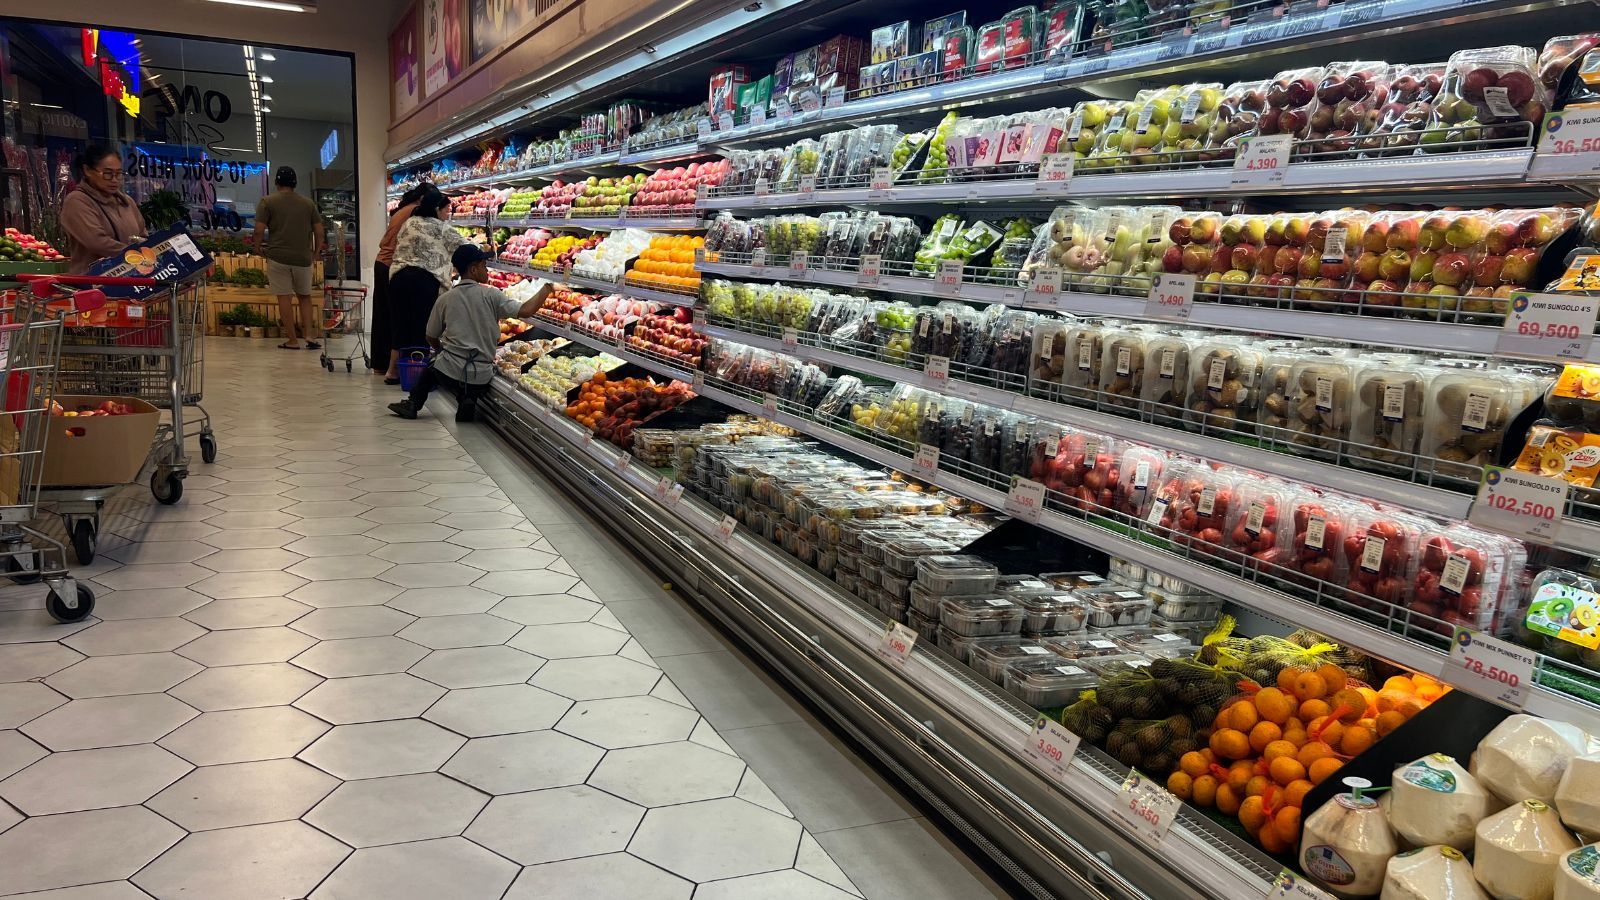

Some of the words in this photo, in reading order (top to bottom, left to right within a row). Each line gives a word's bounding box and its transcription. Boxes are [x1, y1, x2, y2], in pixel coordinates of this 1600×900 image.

[1246, 157, 1278, 170] 4,390
[1035, 285, 1054, 295] 4,050
[1159, 294, 1184, 306] 3,490
[1547, 304, 1579, 312] SUNGOLD
[1518, 321, 1580, 339] 69,500
[1519, 479, 1549, 491] SUNGOLD
[1487, 493, 1555, 520] 102,500
[1471, 640, 1485, 649] KIWI
[1486, 643, 1497, 651] MIX
[1498, 648, 1522, 660] PUNNET
[1463, 656, 1519, 688] 78,500
[1037, 738, 1063, 762] 3,990
[1129, 798, 1160, 825] 5,350
[1296, 883, 1320, 900] KELAPA
